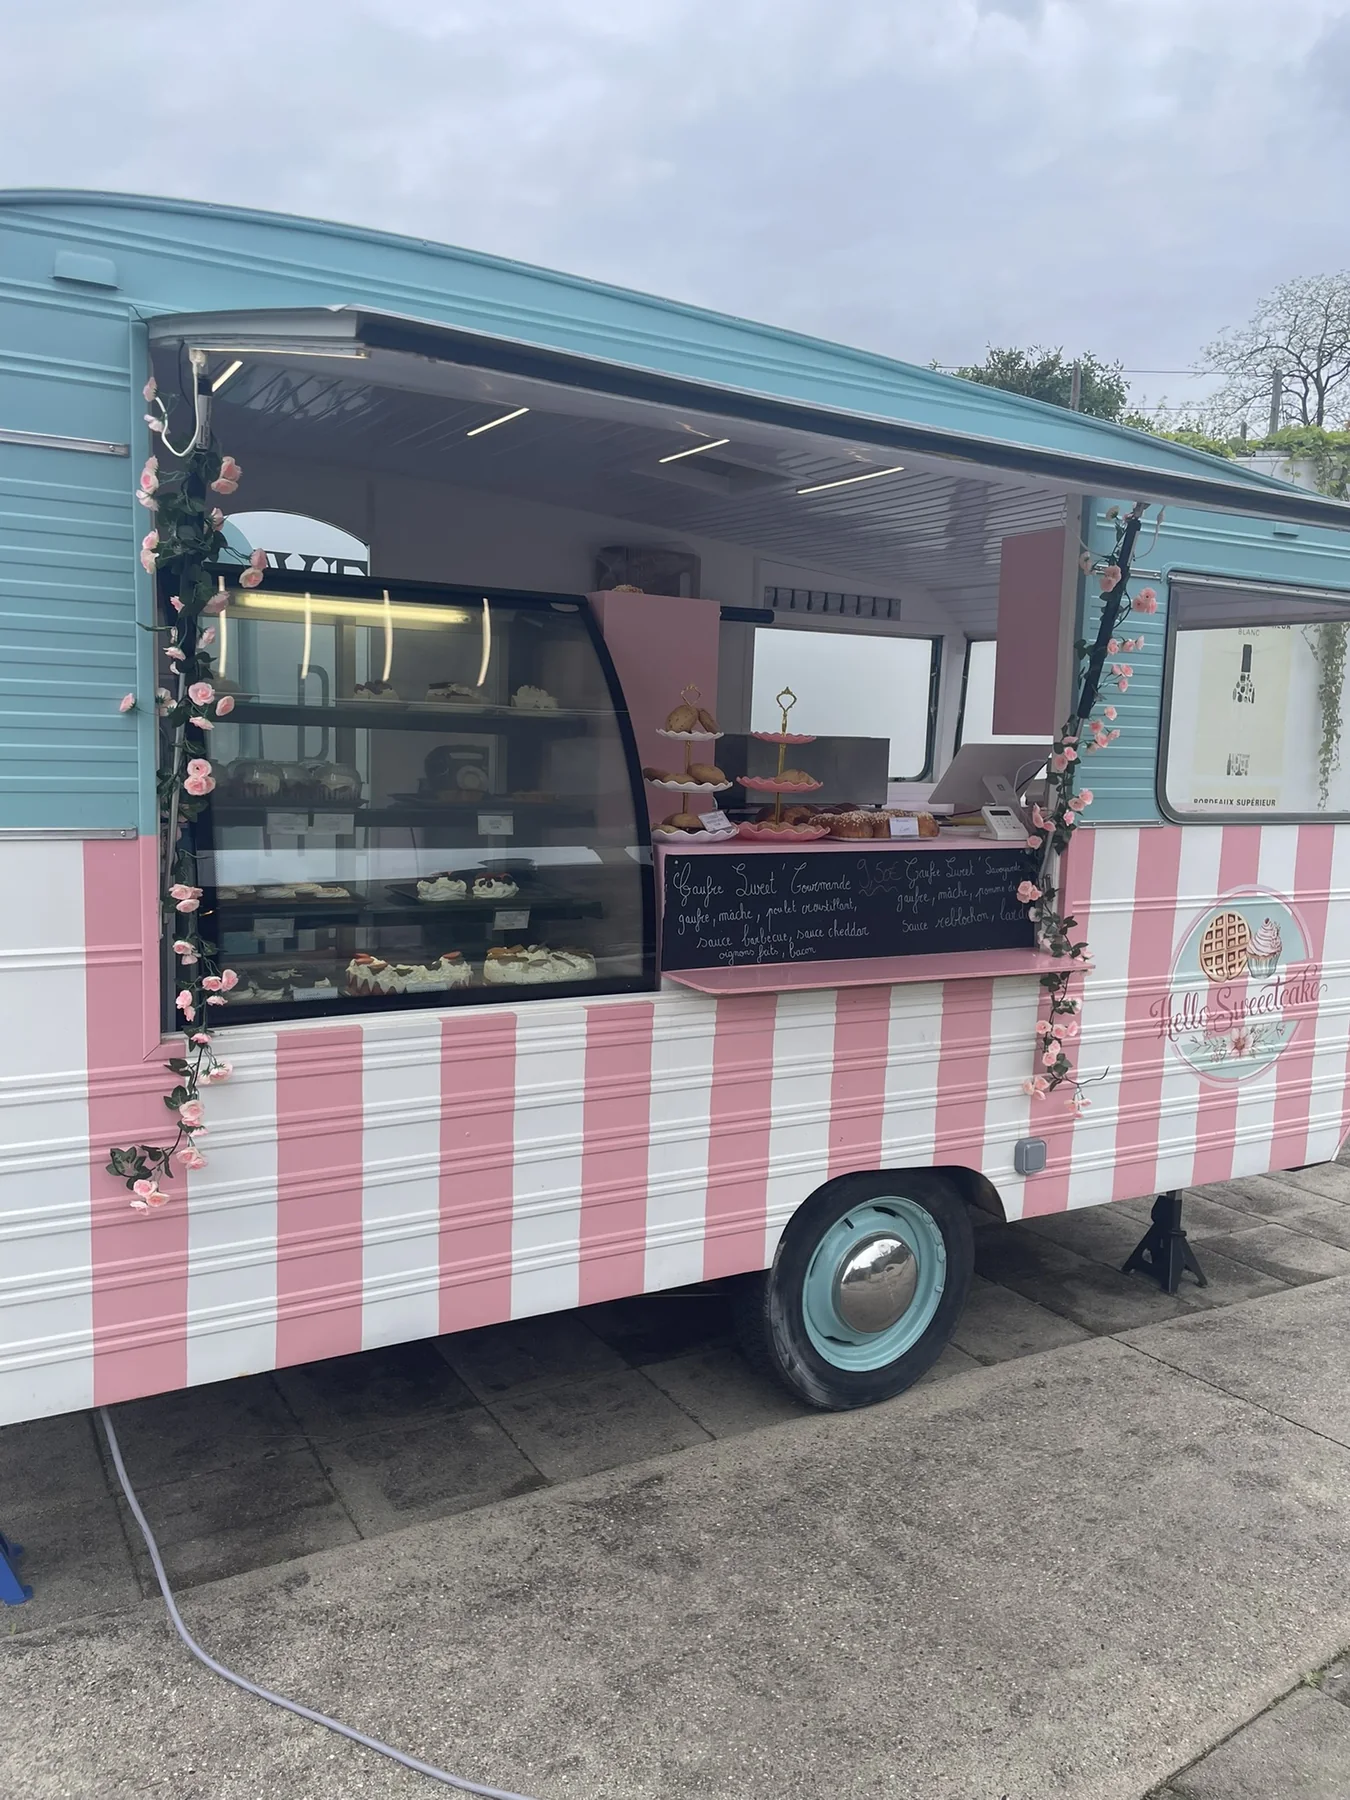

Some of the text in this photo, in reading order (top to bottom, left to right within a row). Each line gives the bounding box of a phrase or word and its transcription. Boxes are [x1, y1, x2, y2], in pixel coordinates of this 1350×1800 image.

[1238, 628, 1260, 637] BLANC
[1236, 796, 1276, 807] SUPÉRIEUR
[673, 862, 724, 907] Gaufre
[790, 862, 851, 894] Gourmande
[904, 857, 941, 889] Gaufre
[765, 899, 797, 932] poulet
[999, 897, 1029, 921] lard
[696, 936, 733, 949] sauce
[796, 926, 825, 941] sauce
[828, 919, 870, 937] cheddar
[718, 947, 755, 966] oignons
[789, 941, 817, 959] bacon
[1149, 991, 1211, 1042] Hello
